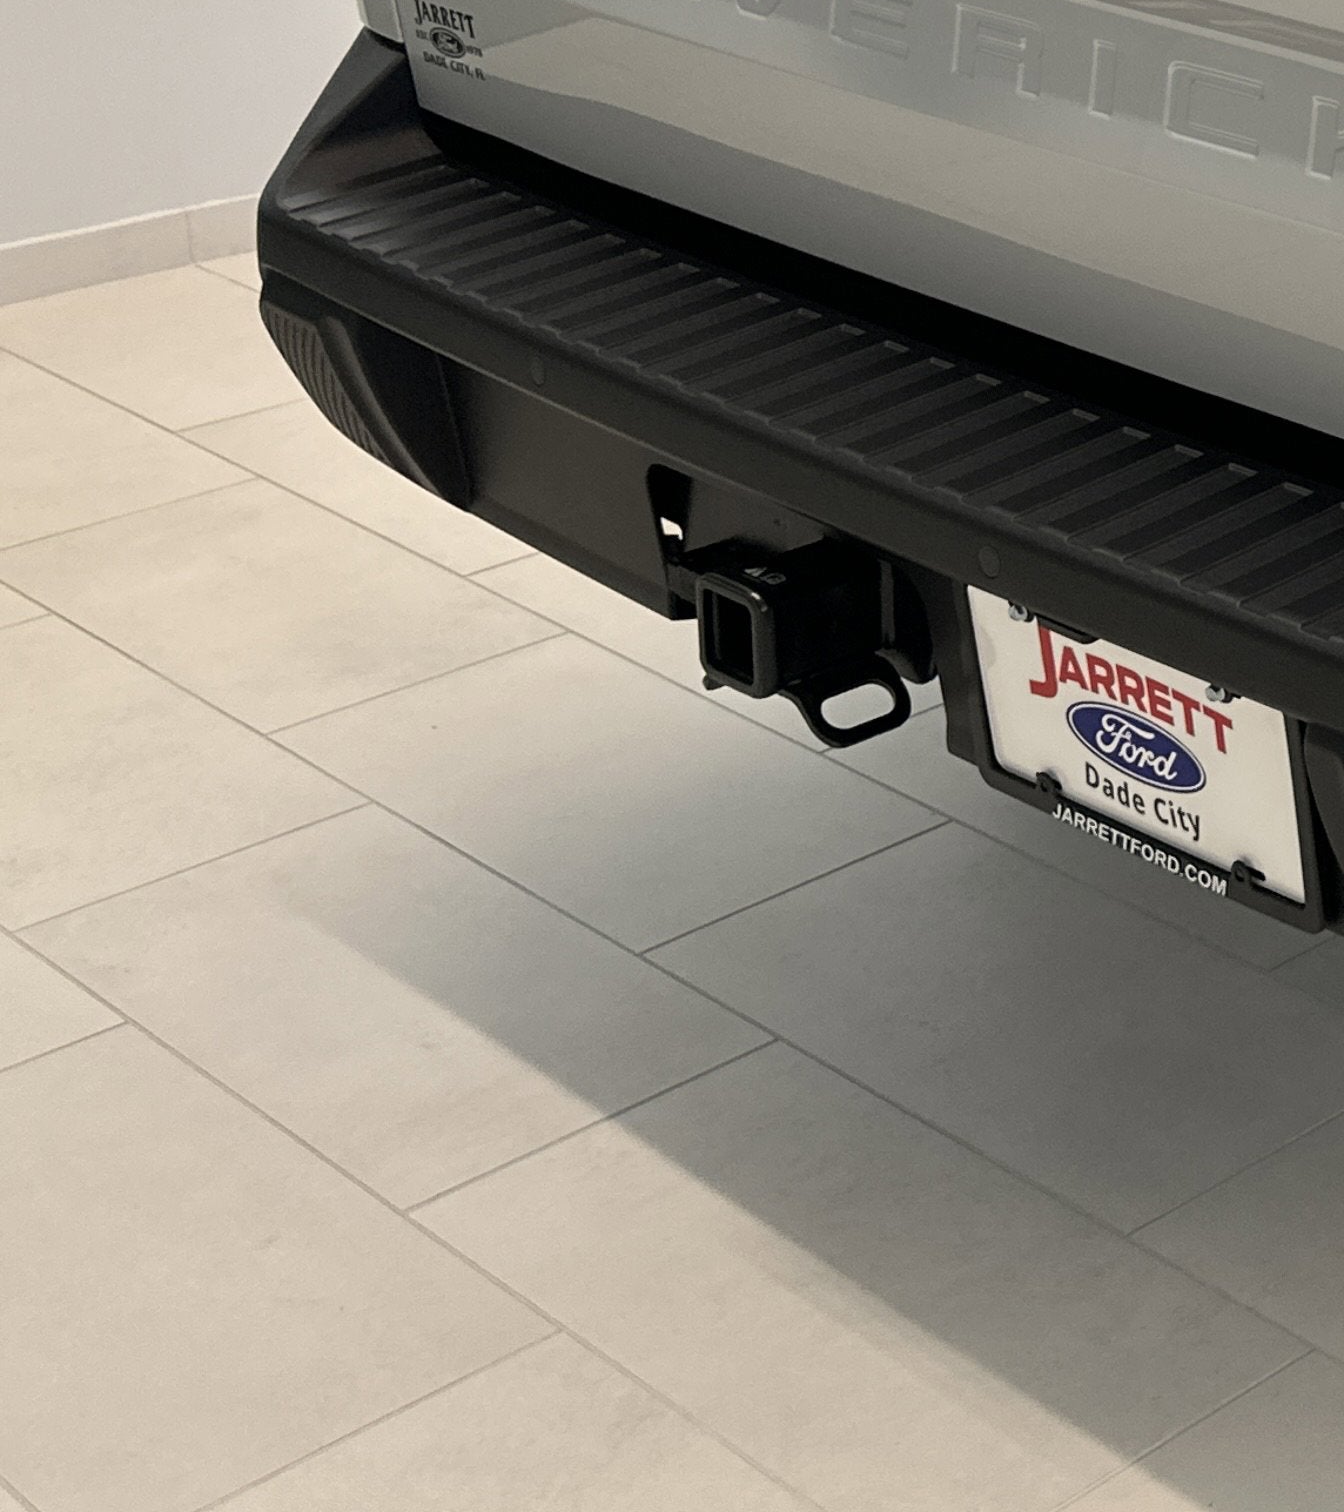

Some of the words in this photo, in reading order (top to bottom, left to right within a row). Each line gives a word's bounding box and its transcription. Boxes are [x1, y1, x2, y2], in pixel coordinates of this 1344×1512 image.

[1029, 624, 1233, 754] JARRETT
[1096, 713, 1178, 780] Ford
[1085, 761, 1146, 815] Dade
[1154, 797, 1200, 840] City
[1052, 803, 1228, 896] JARRETTFORD.COM
